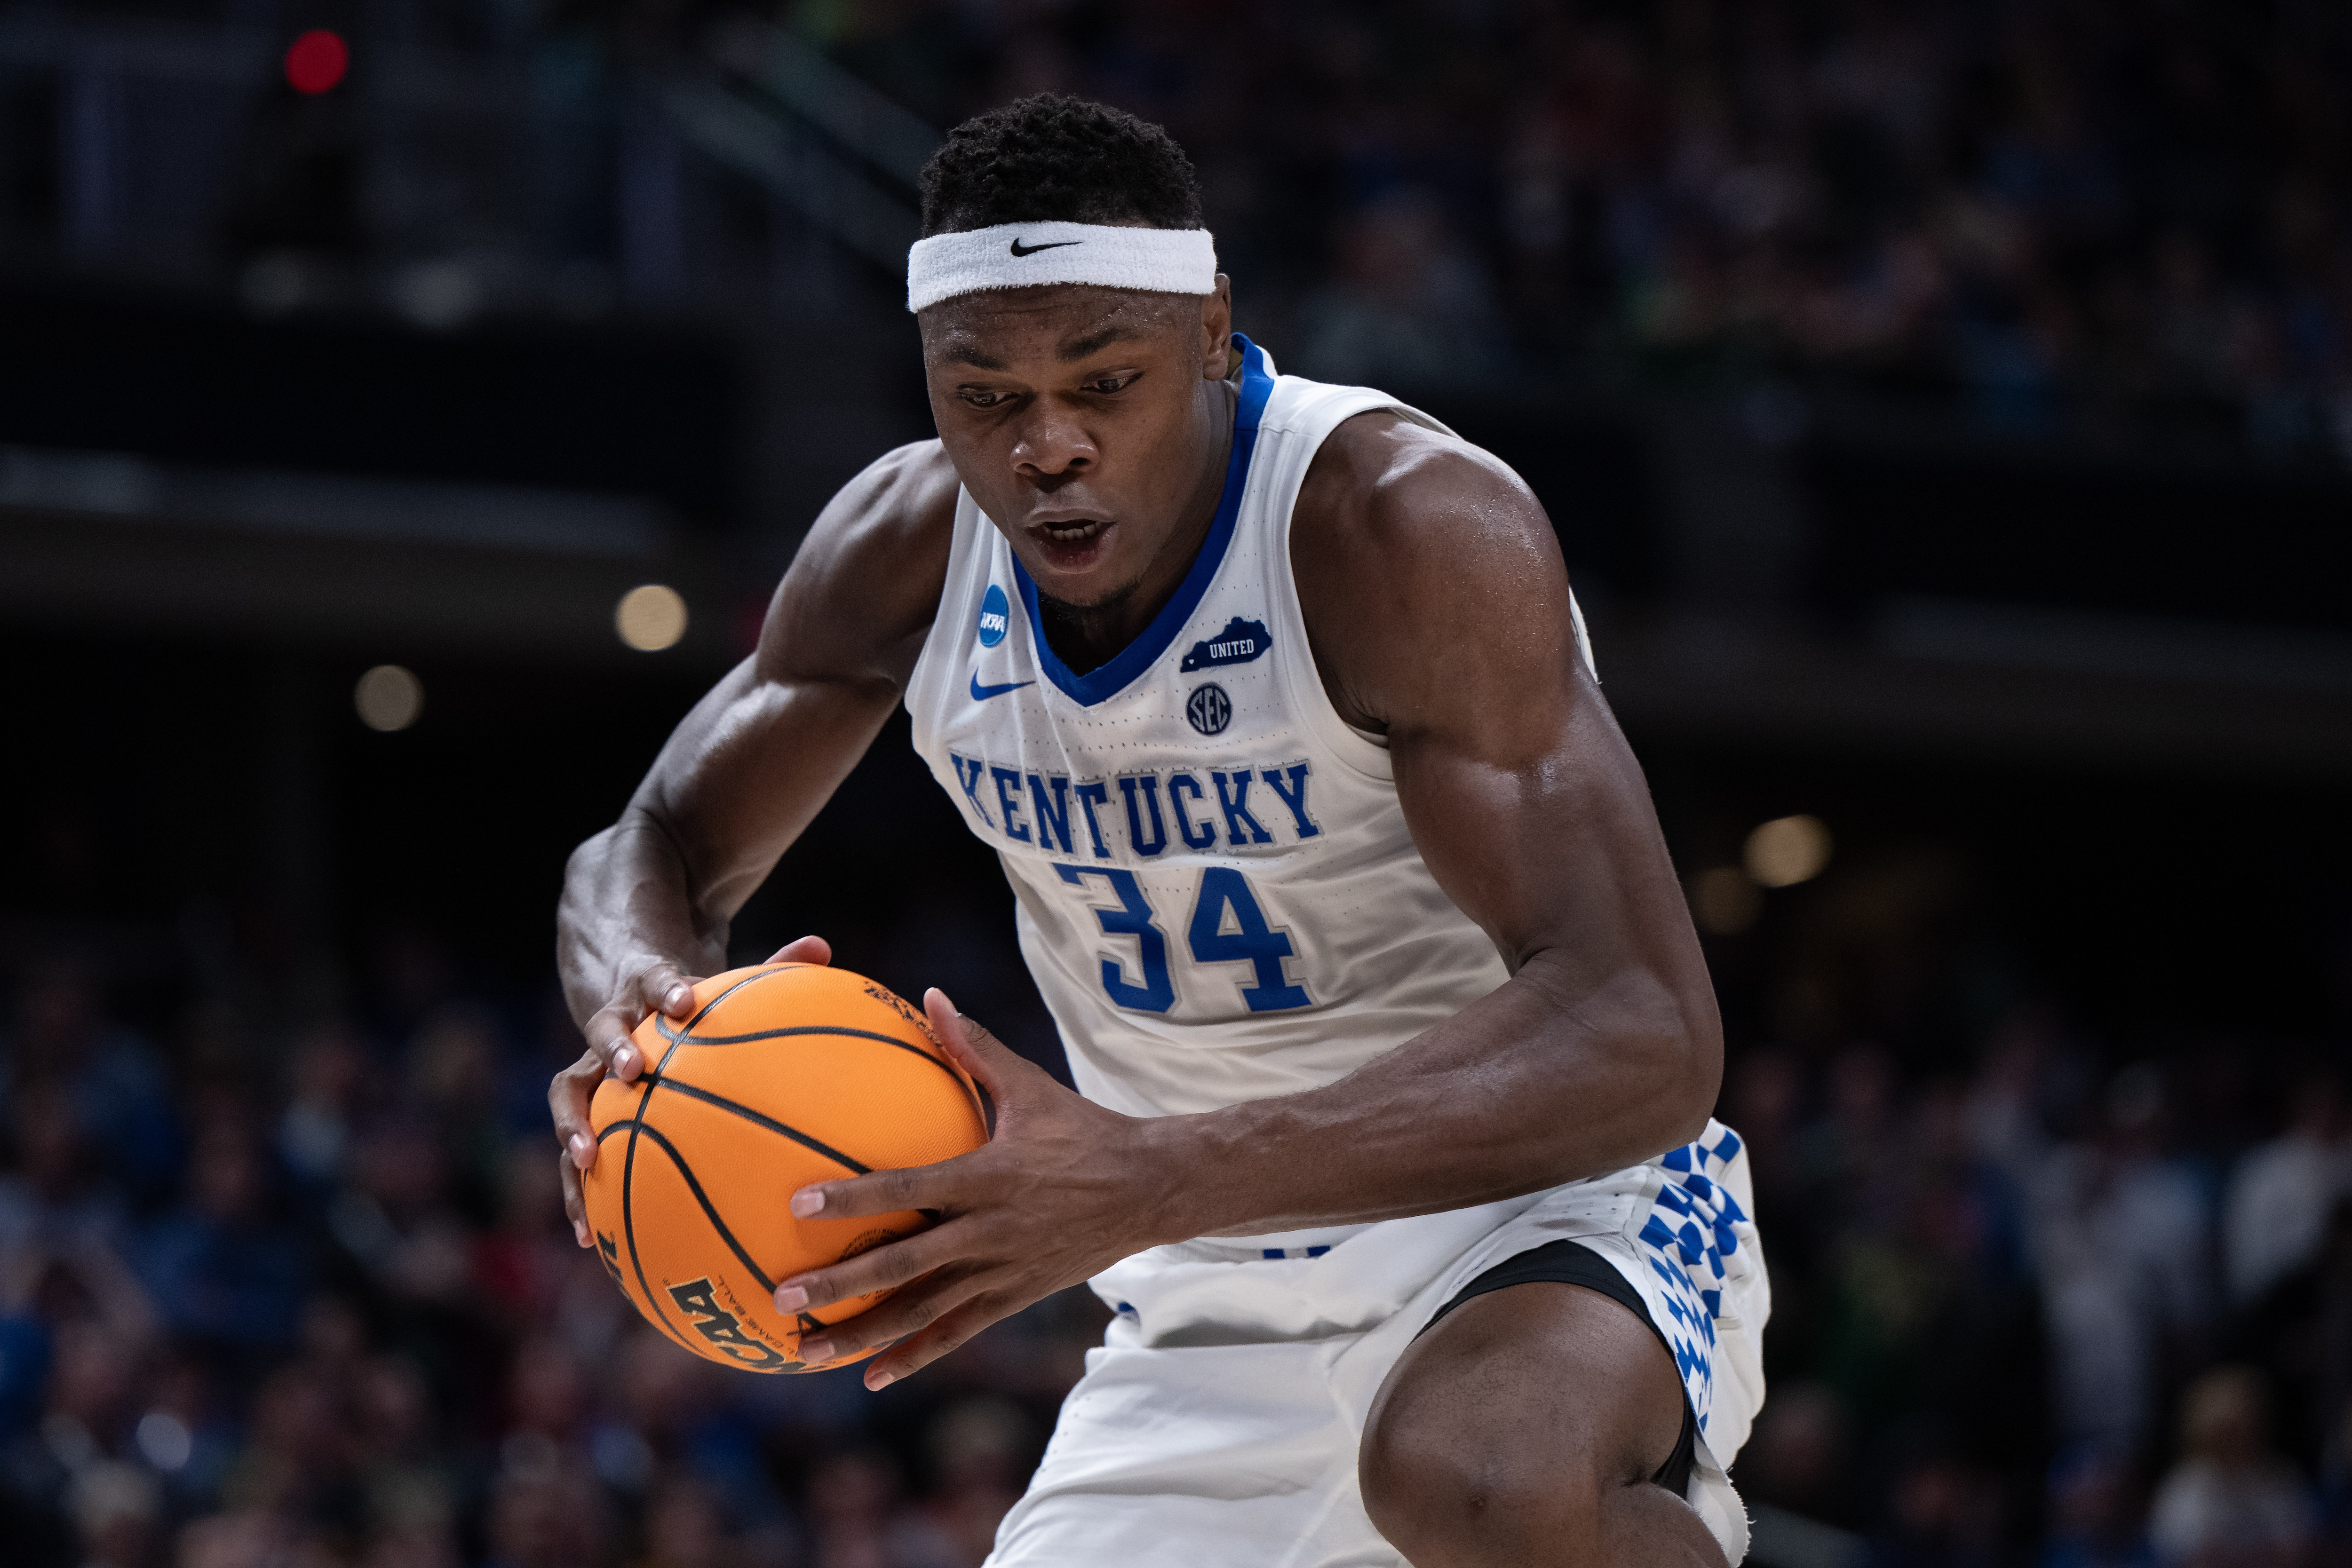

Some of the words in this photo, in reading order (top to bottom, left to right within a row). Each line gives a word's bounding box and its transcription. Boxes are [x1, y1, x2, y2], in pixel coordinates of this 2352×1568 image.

[1209, 639, 1255, 658] UNITED
[1190, 687, 1228, 732] SEC
[949, 752, 1324, 859] KENTUCKY
[1049, 862, 1321, 1018] 34
